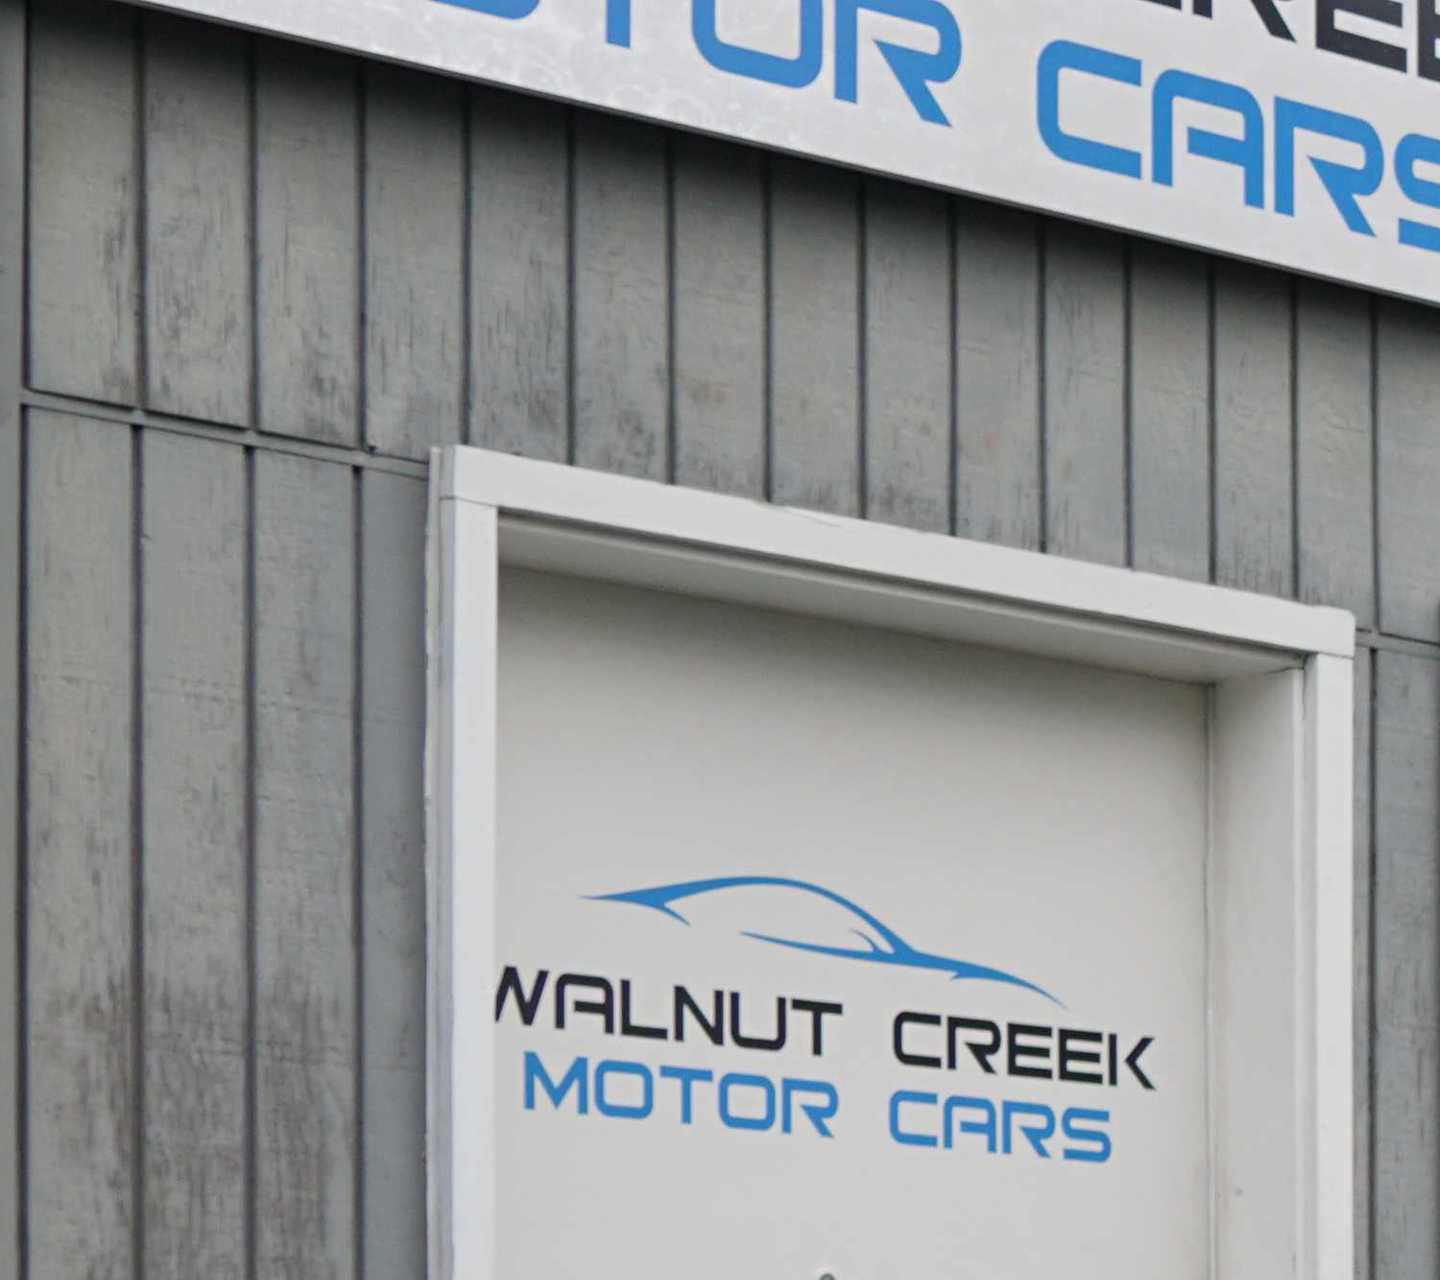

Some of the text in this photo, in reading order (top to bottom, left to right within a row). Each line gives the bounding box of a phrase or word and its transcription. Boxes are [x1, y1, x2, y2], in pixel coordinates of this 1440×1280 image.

[495, 966, 1157, 1091] WALNUT CREEK
[523, 1050, 1112, 1163] MOTOR CARS
